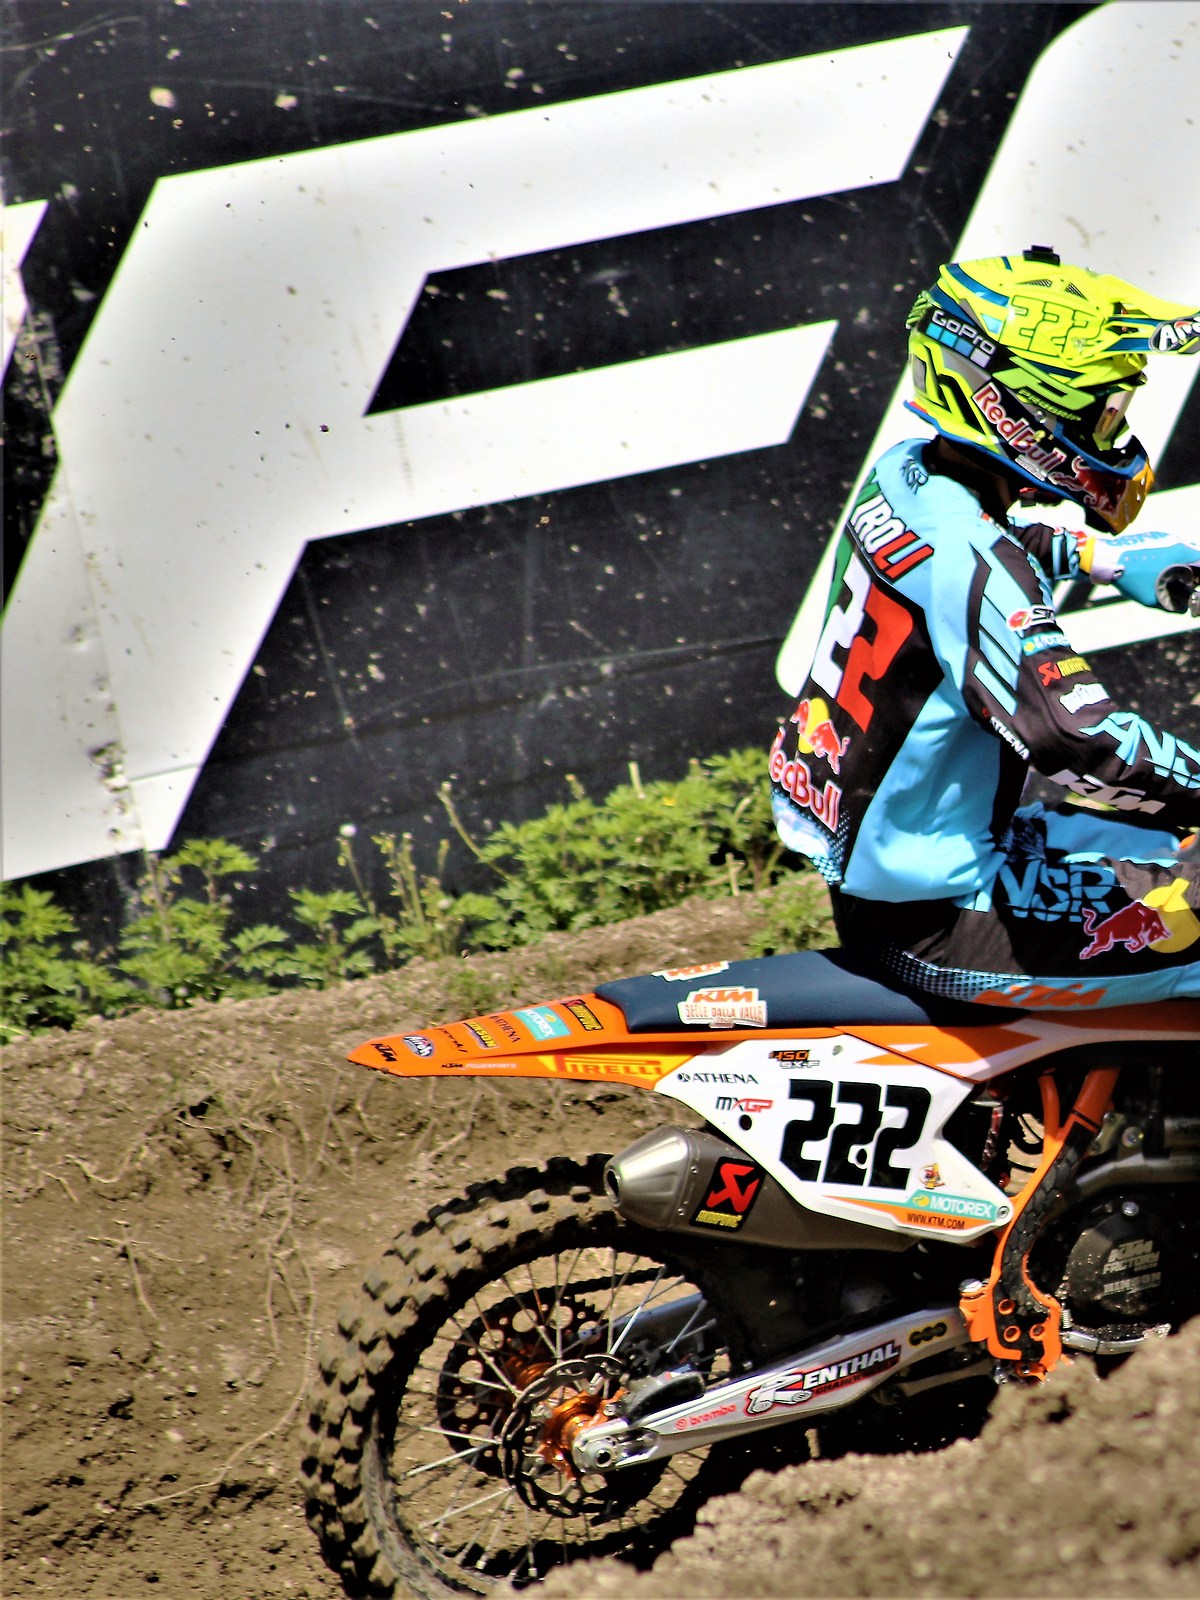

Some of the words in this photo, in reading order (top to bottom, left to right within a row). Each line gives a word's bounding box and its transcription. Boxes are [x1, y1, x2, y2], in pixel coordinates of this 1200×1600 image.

[809, 533, 914, 735] 22
[693, 989, 754, 1003] KTM
[554, 1055, 662, 1076] PIRELLI
[692, 1072, 759, 1085] ATHENA
[779, 1078, 932, 1190] 222
[930, 1196, 993, 1218] MOTOREX
[906, 1212, 966, 1230] WWW.KTM.COM
